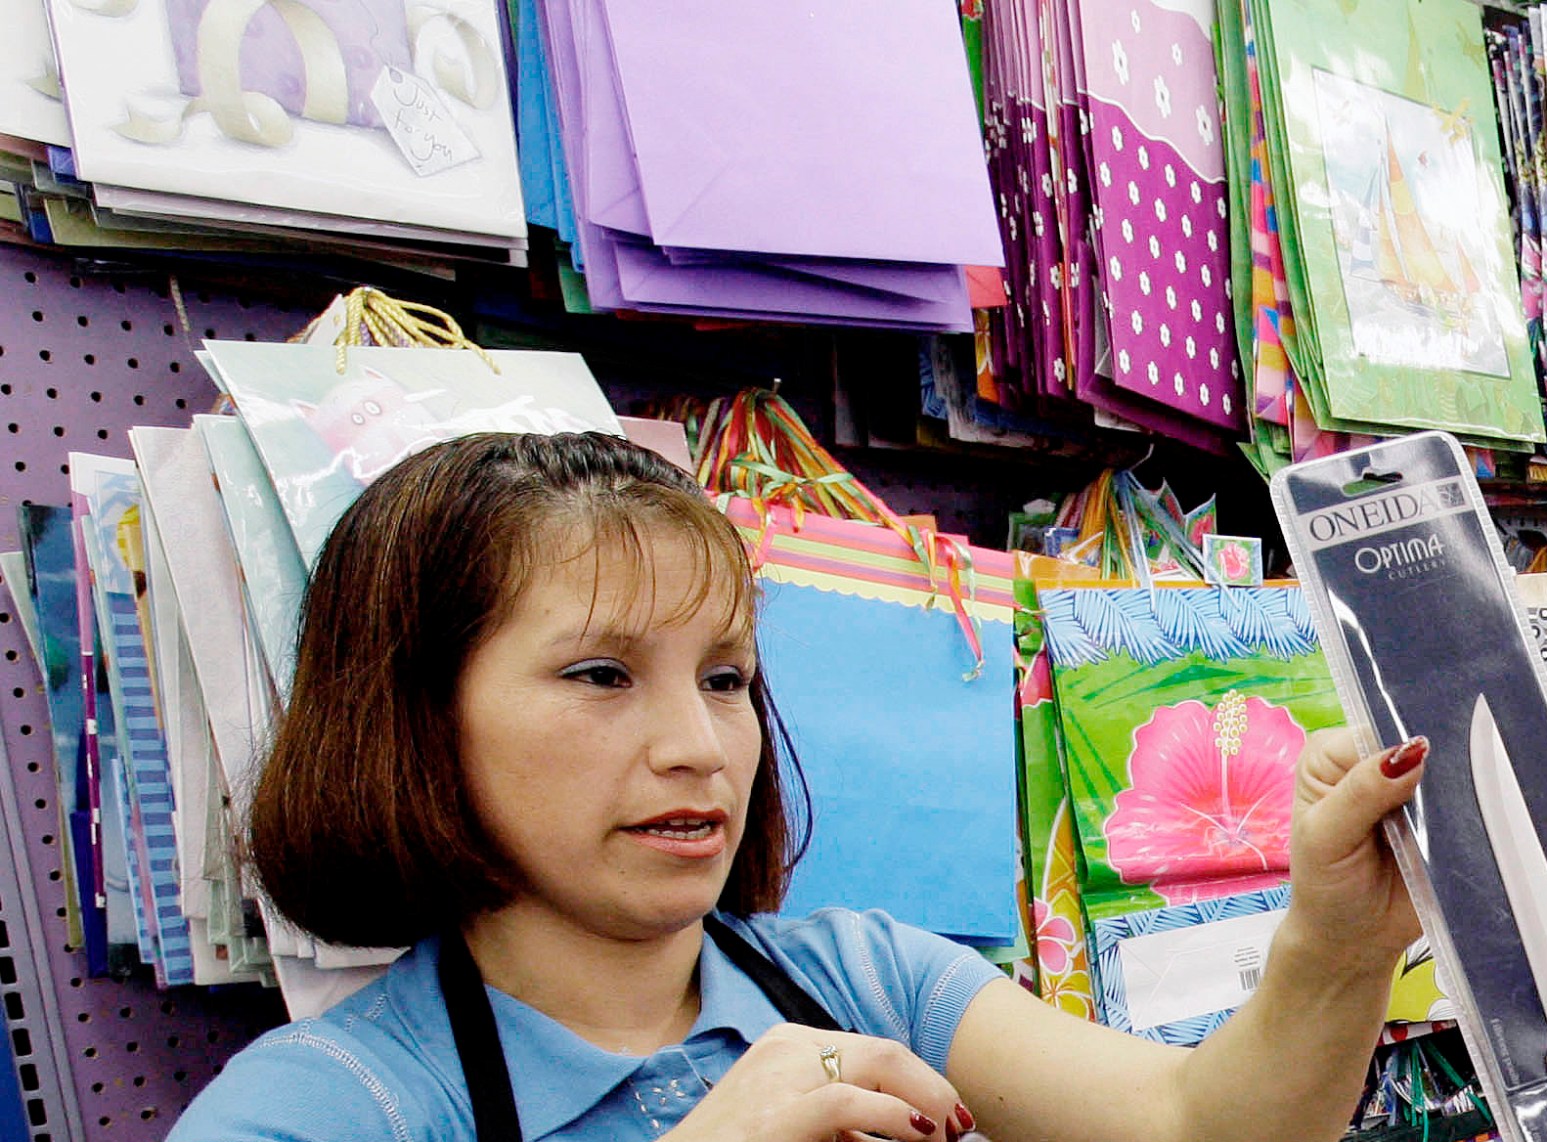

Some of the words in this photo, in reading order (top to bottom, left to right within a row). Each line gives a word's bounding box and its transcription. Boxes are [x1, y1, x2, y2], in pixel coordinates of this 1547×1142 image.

[393, 82, 443, 121] Just
[409, 133, 453, 162] you
[1309, 488, 1441, 541] ONEIDA
